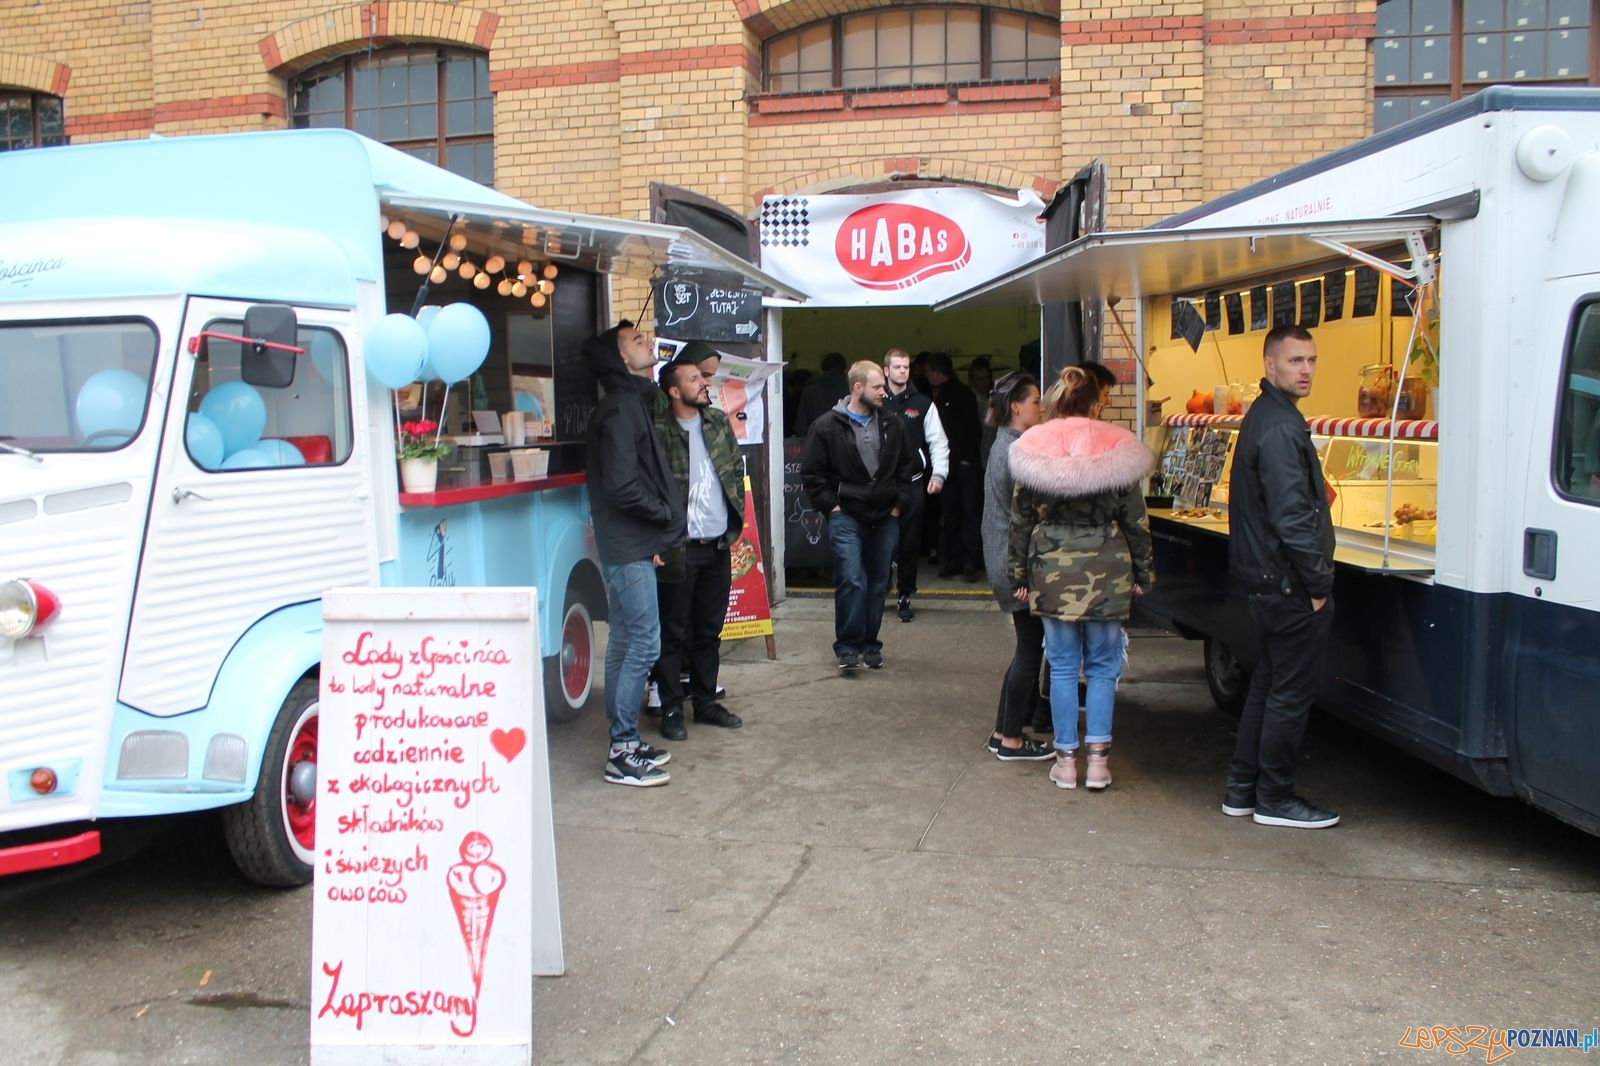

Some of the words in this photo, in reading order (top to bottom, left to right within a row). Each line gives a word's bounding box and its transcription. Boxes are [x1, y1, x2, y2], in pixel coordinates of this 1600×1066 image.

[851, 217, 947, 267] HABAS
[709, 301, 740, 315] TUTAJ
[342, 631, 403, 679] Lody
[328, 675, 345, 693] to
[352, 674, 386, 711] lody
[392, 672, 497, 699] naturalne
[354, 706, 489, 740] produkowane
[353, 737, 465, 764] codziennie
[327, 779, 340, 794] z
[349, 761, 500, 809] ekologicznych
[324, 848, 332, 874] i
[327, 878, 407, 904] owoców
[318, 960, 478, 1038] Zapraszamy
